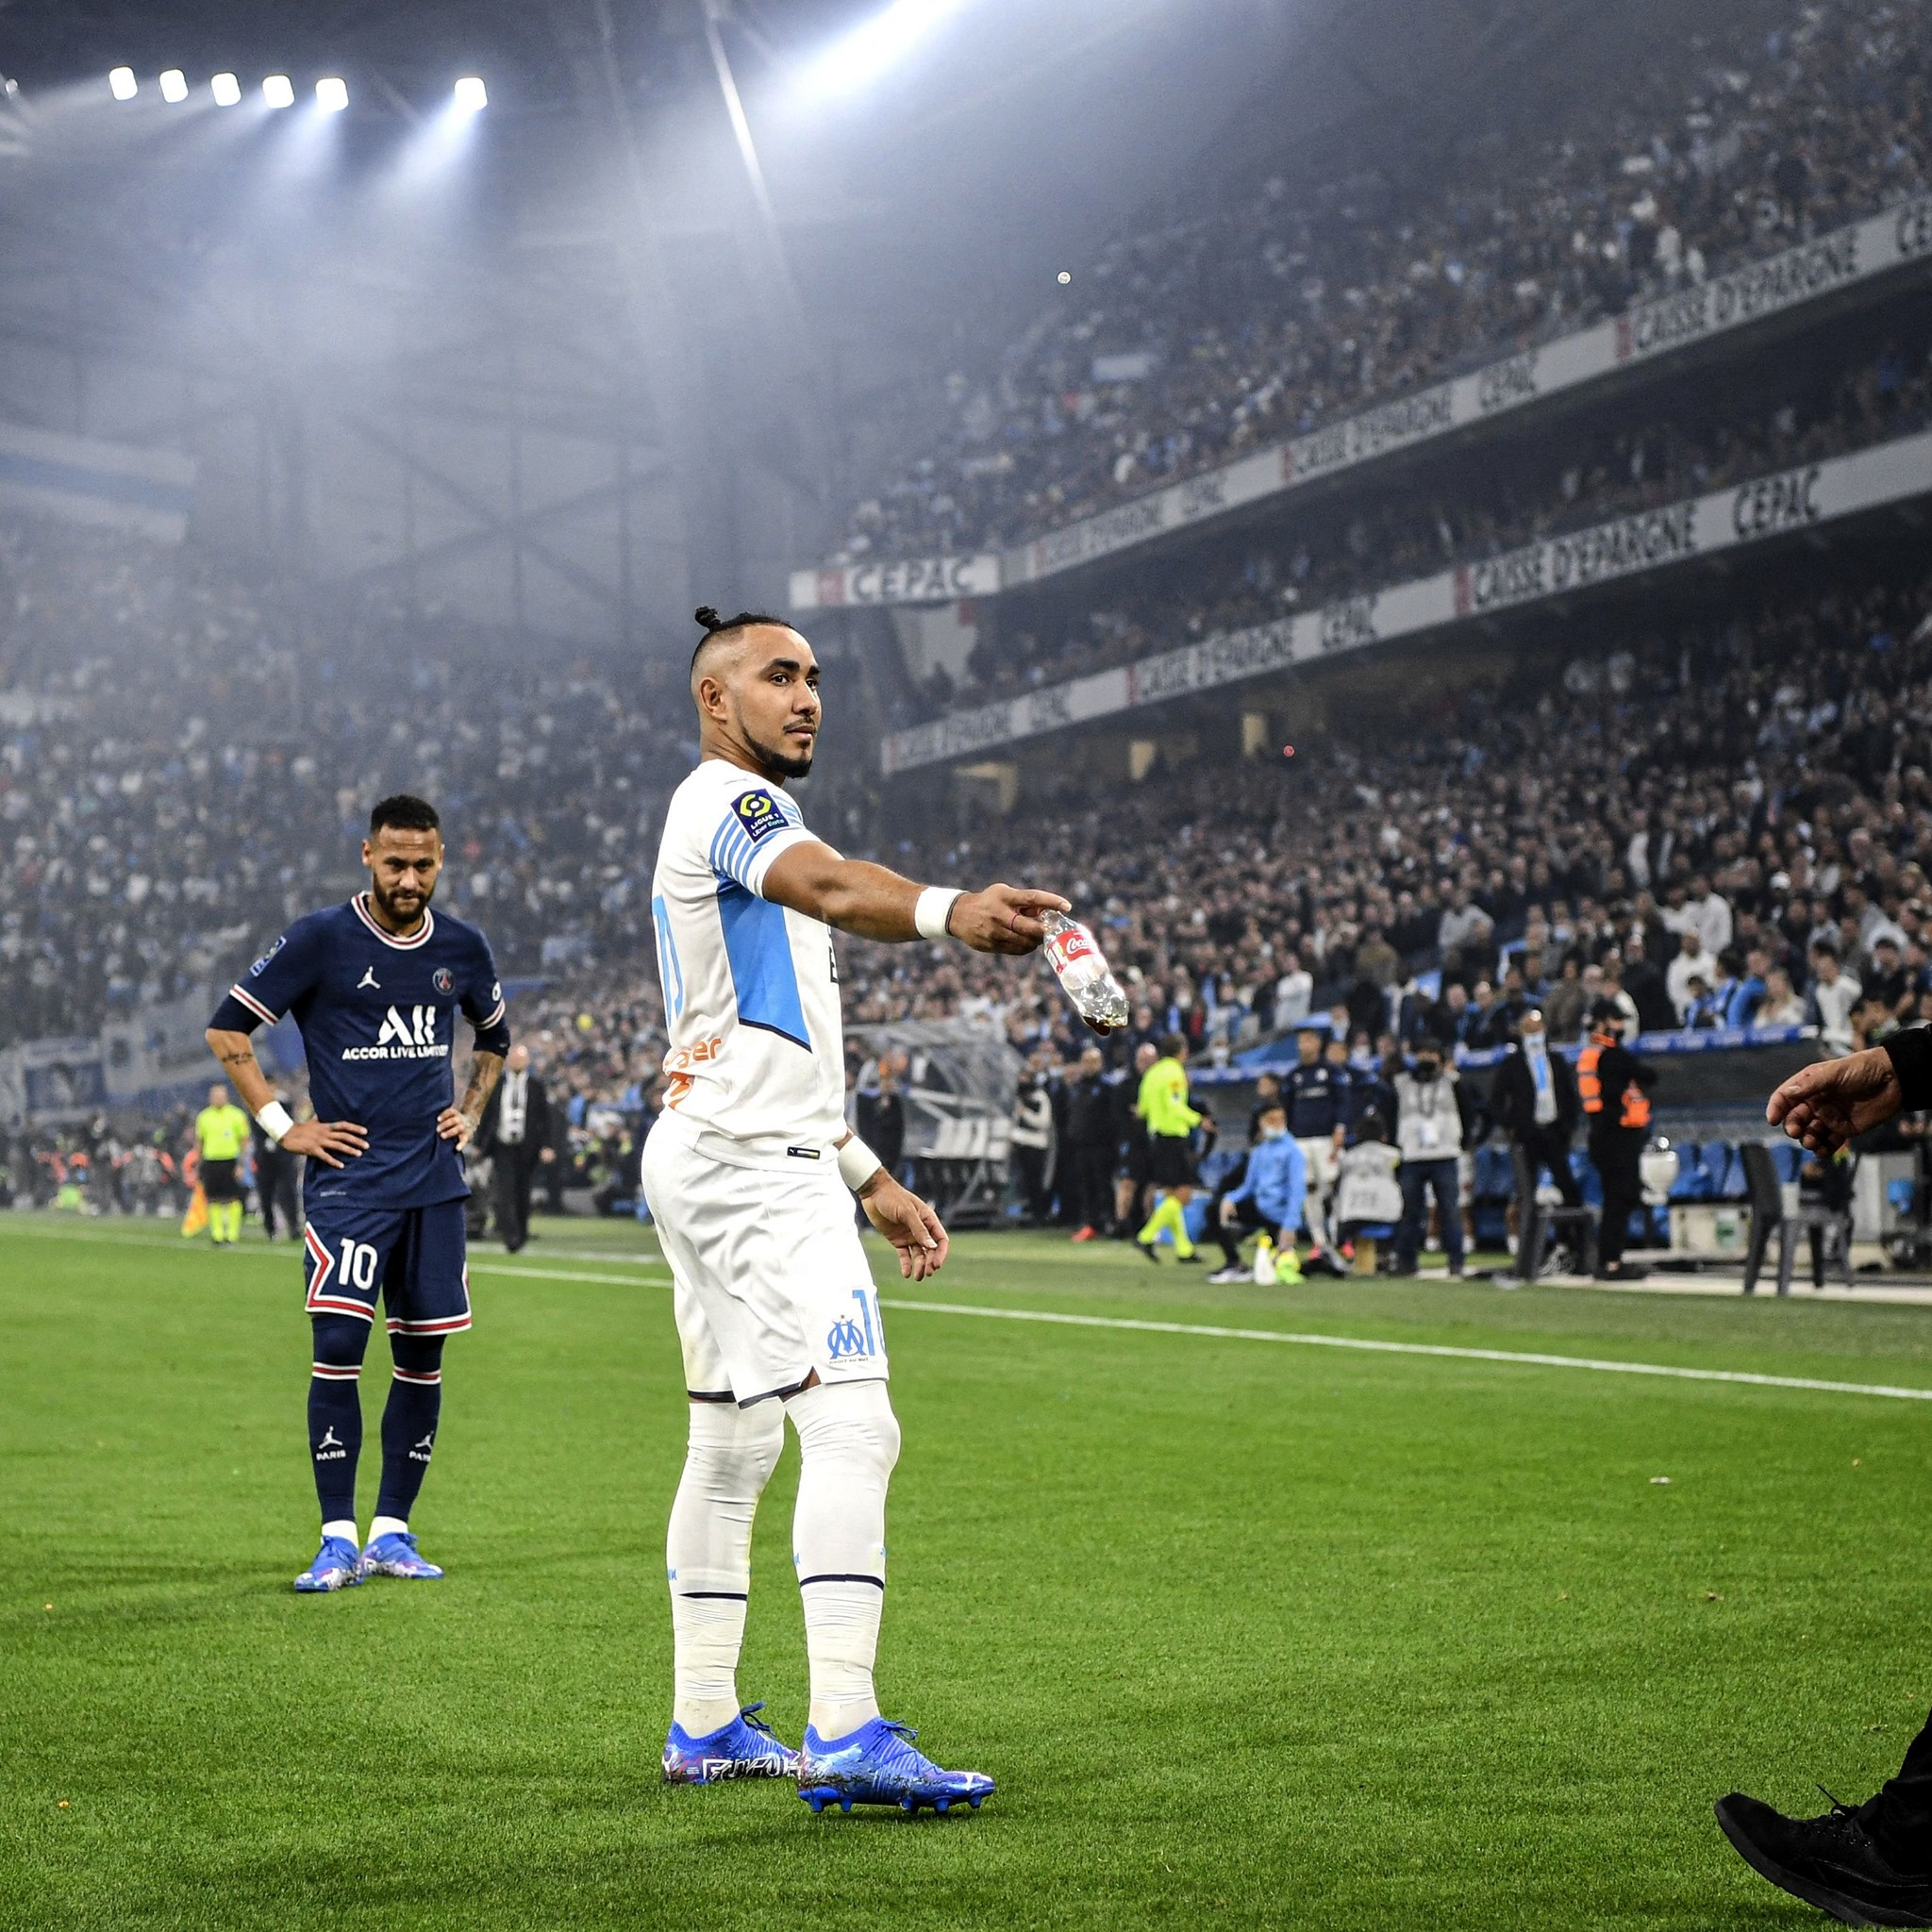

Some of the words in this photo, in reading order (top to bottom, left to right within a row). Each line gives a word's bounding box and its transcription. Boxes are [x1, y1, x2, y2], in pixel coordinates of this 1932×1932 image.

[1733, 466, 1820, 537] CEPAC
[852, 558, 977, 602] CEPAC
[750, 814, 774, 830] LIGUE
[341, 1047, 389, 1060] ACCOR
[390, 1046, 416, 1058] LIVE
[338, 1237, 378, 1291] 10
[316, 1449, 346, 1461] PARIS
